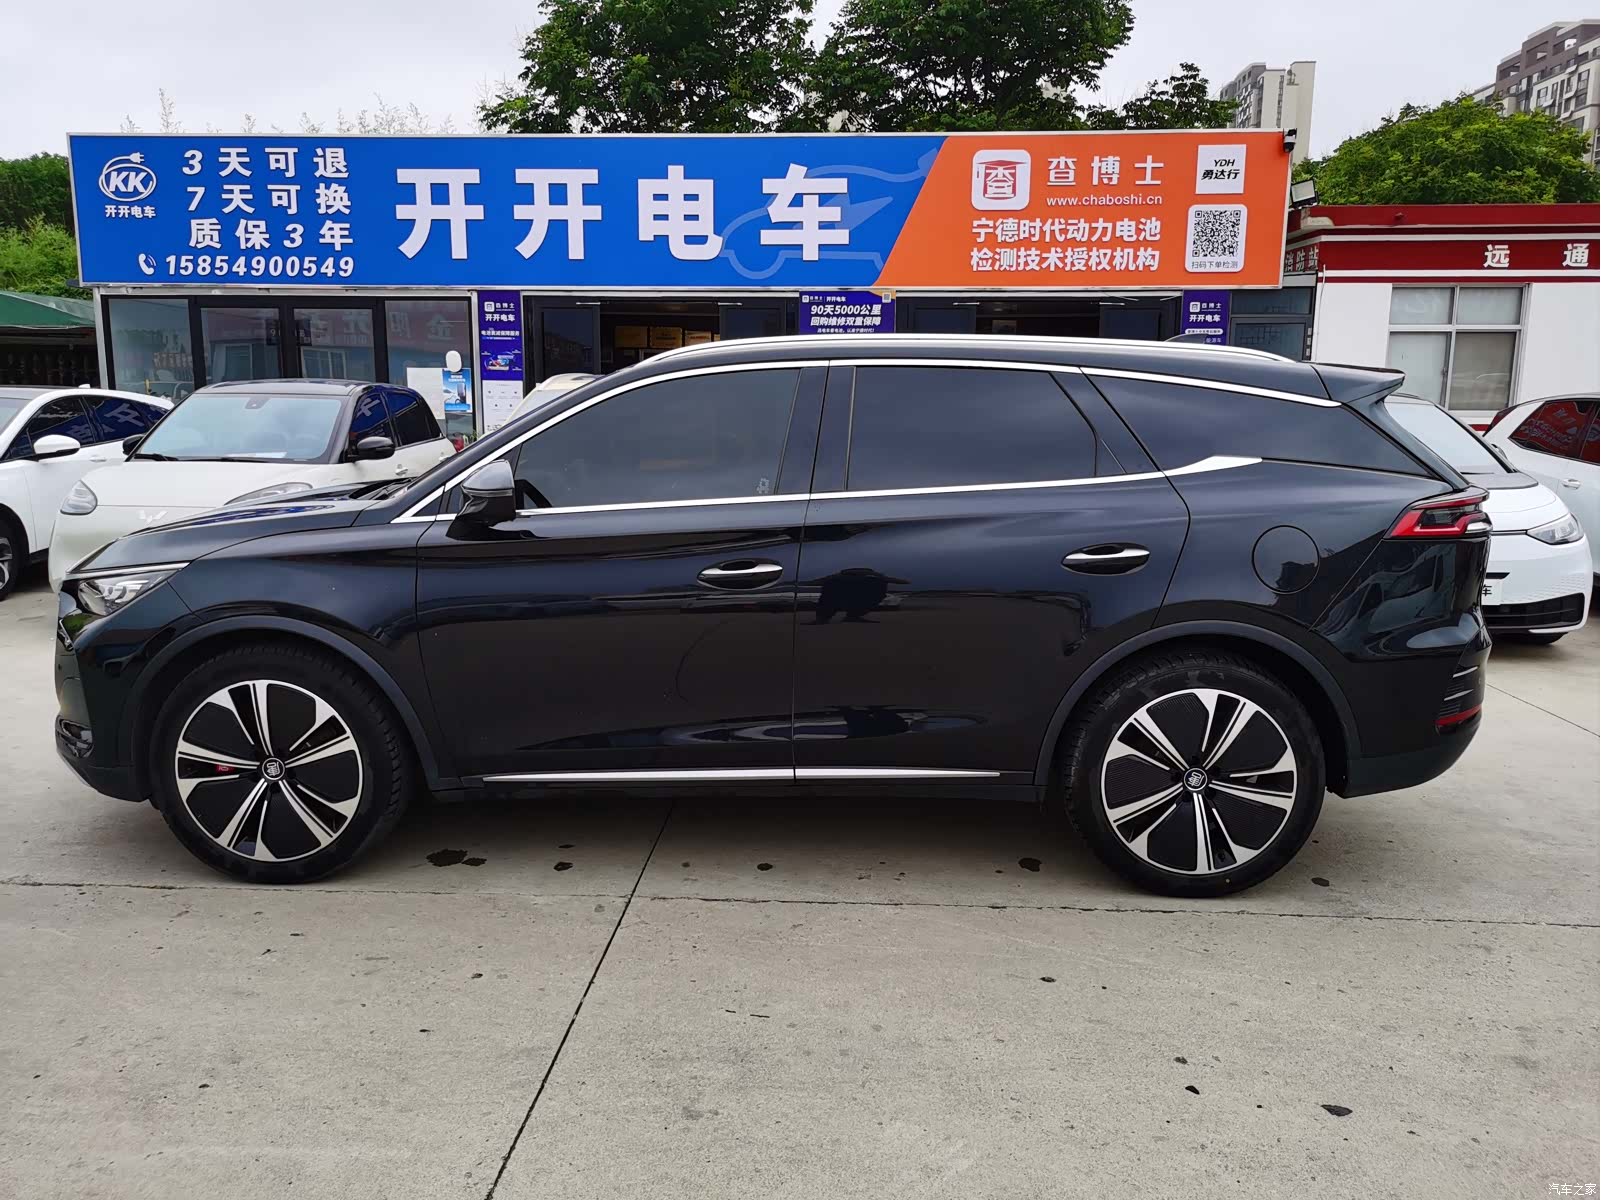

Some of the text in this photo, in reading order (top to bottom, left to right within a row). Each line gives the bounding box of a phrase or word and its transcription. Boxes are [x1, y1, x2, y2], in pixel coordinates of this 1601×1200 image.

[182, 147, 349, 179] 3天可退
[1046, 155, 1165, 186] 查博士
[1213, 158, 1235, 168] YDH
[108, 171, 148, 193] KK
[1201, 168, 1240, 182] 勇达行
[186, 183, 352, 216] 7天可换
[1046, 193, 1163, 206] www.chaboshi.cn
[105, 204, 156, 219] 开开电车
[394, 162, 850, 261] 开开电车
[188, 218, 354, 251] 质保3年
[971, 217, 1161, 243] 宁德时代动力电池
[165, 255, 355, 278] 15854900549
[970, 246, 1160, 273] 检测技术授权机构
[1191, 260, 1239, 269] 扫码下单检测
[1483, 243, 1589, 268] 远通
[485, 313, 515, 322] 开开电车
[810, 304, 882, 315] 90天5000公里
[1189, 314, 1221, 322] 开开电车
[810, 316, 882, 326] 回购维修双重保障
